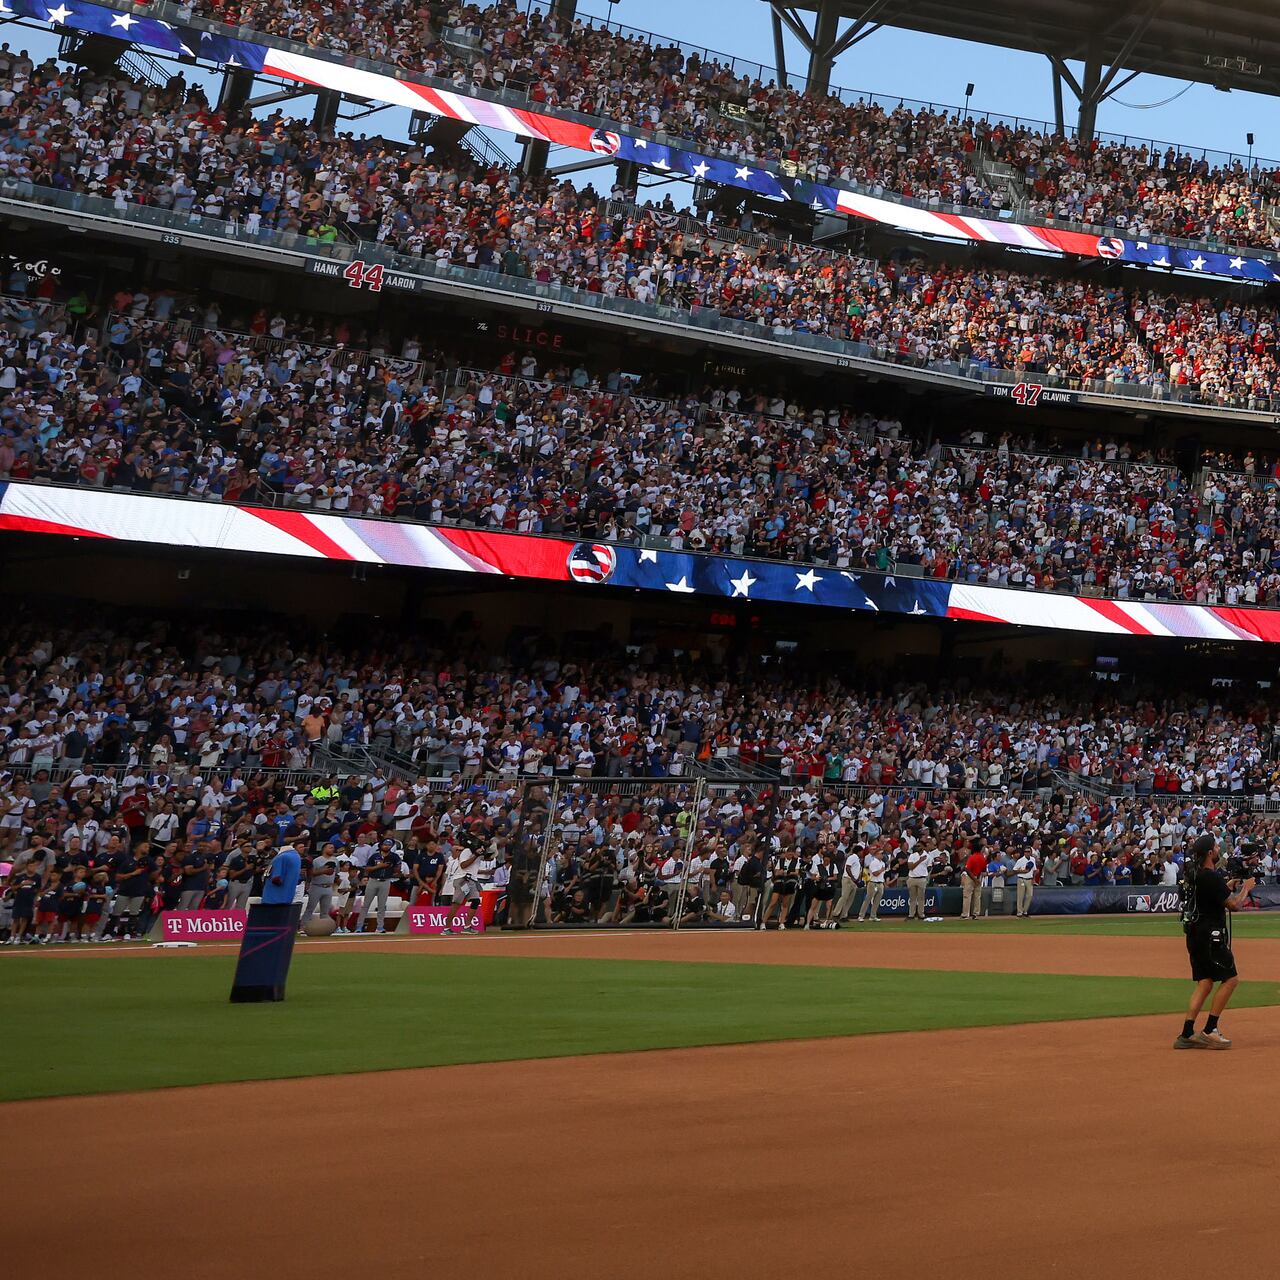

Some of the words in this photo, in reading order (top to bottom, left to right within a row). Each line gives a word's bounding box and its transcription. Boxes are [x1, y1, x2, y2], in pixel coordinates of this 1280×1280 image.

[163, 234, 180, 245] 335
[313, 261, 340, 276] HANK
[343, 260, 385, 292] 44
[385, 275, 416, 290] AARON
[538, 304, 551, 312] 337
[497, 325, 562, 348] SLICE
[993, 386, 1008, 396] TOM
[1011, 382, 1043, 406] 47
[1042, 391, 1071, 403] GLAVINE
[880, 895, 906, 910] oogle
[1151, 892, 1179, 912] All
[186, 917, 244, 934] Mobile
